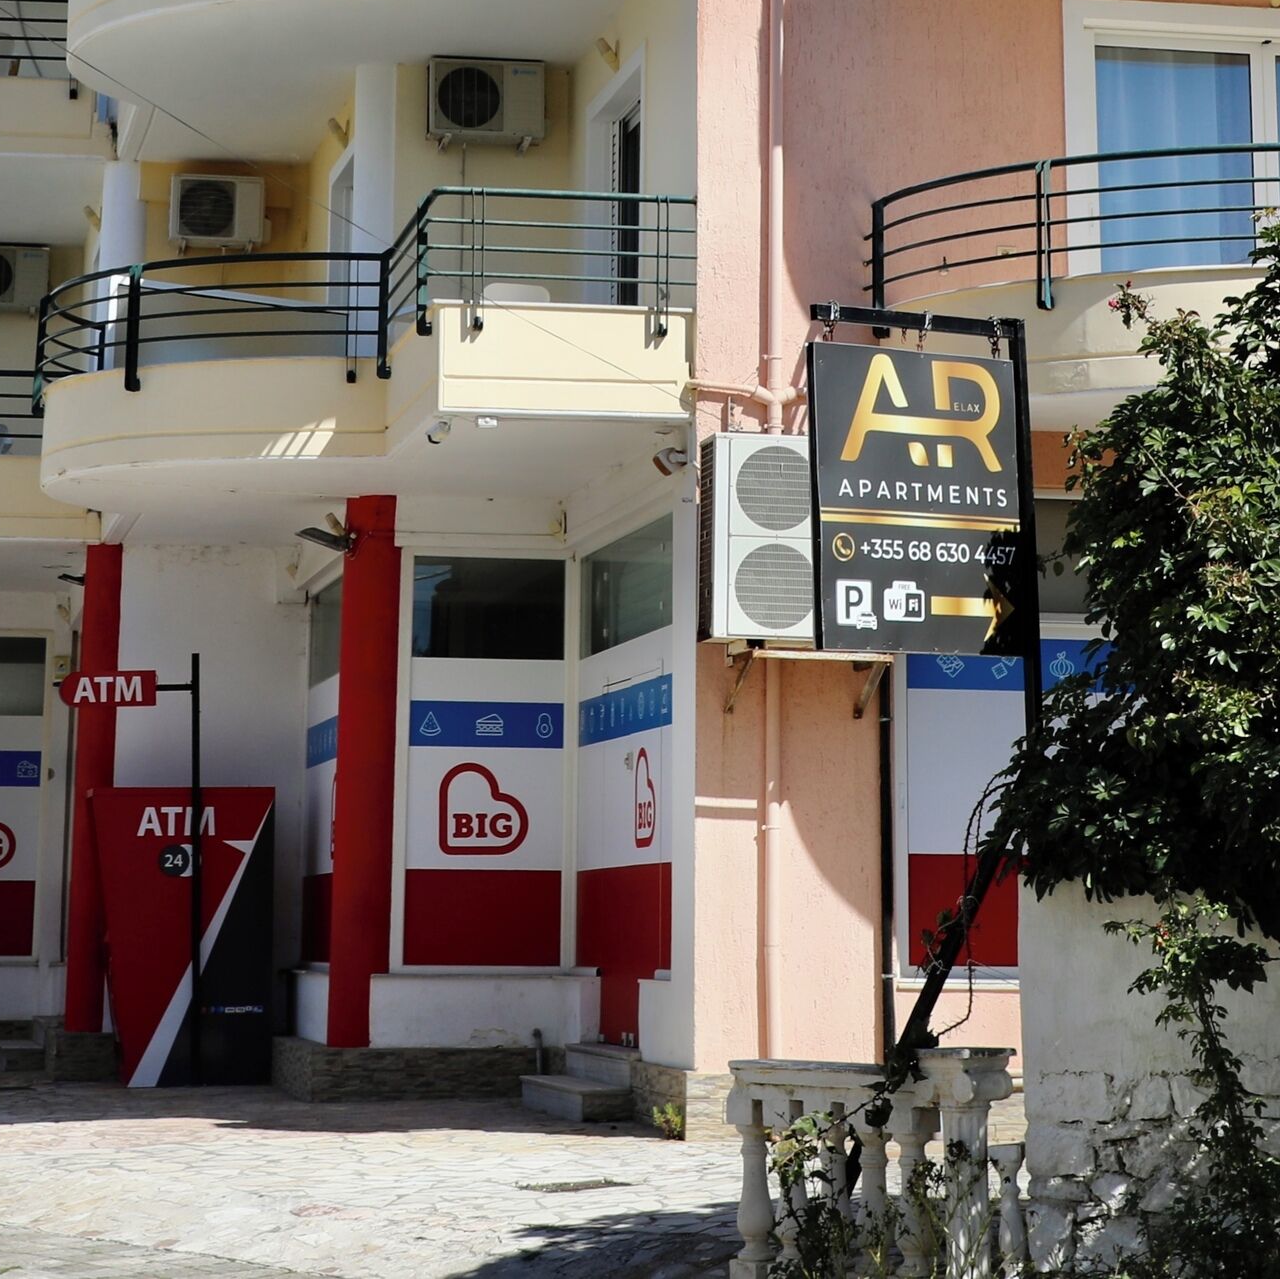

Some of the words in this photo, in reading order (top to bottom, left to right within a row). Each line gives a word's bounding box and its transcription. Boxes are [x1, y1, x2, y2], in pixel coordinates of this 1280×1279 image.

[838, 478, 1008, 507] APARTMENTS
[860, 538, 904, 560] +355
[908, 540, 932, 562] 68
[936, 542, 970, 563] 630
[974, 544, 1016, 566] 4457
[845, 585, 864, 620] P
[73, 675, 143, 703] ATM
[137, 806, 216, 837] ATM
[452, 812, 513, 839] BIG
[638, 801, 652, 830] BIG
[164, 853, 184, 868] 24
